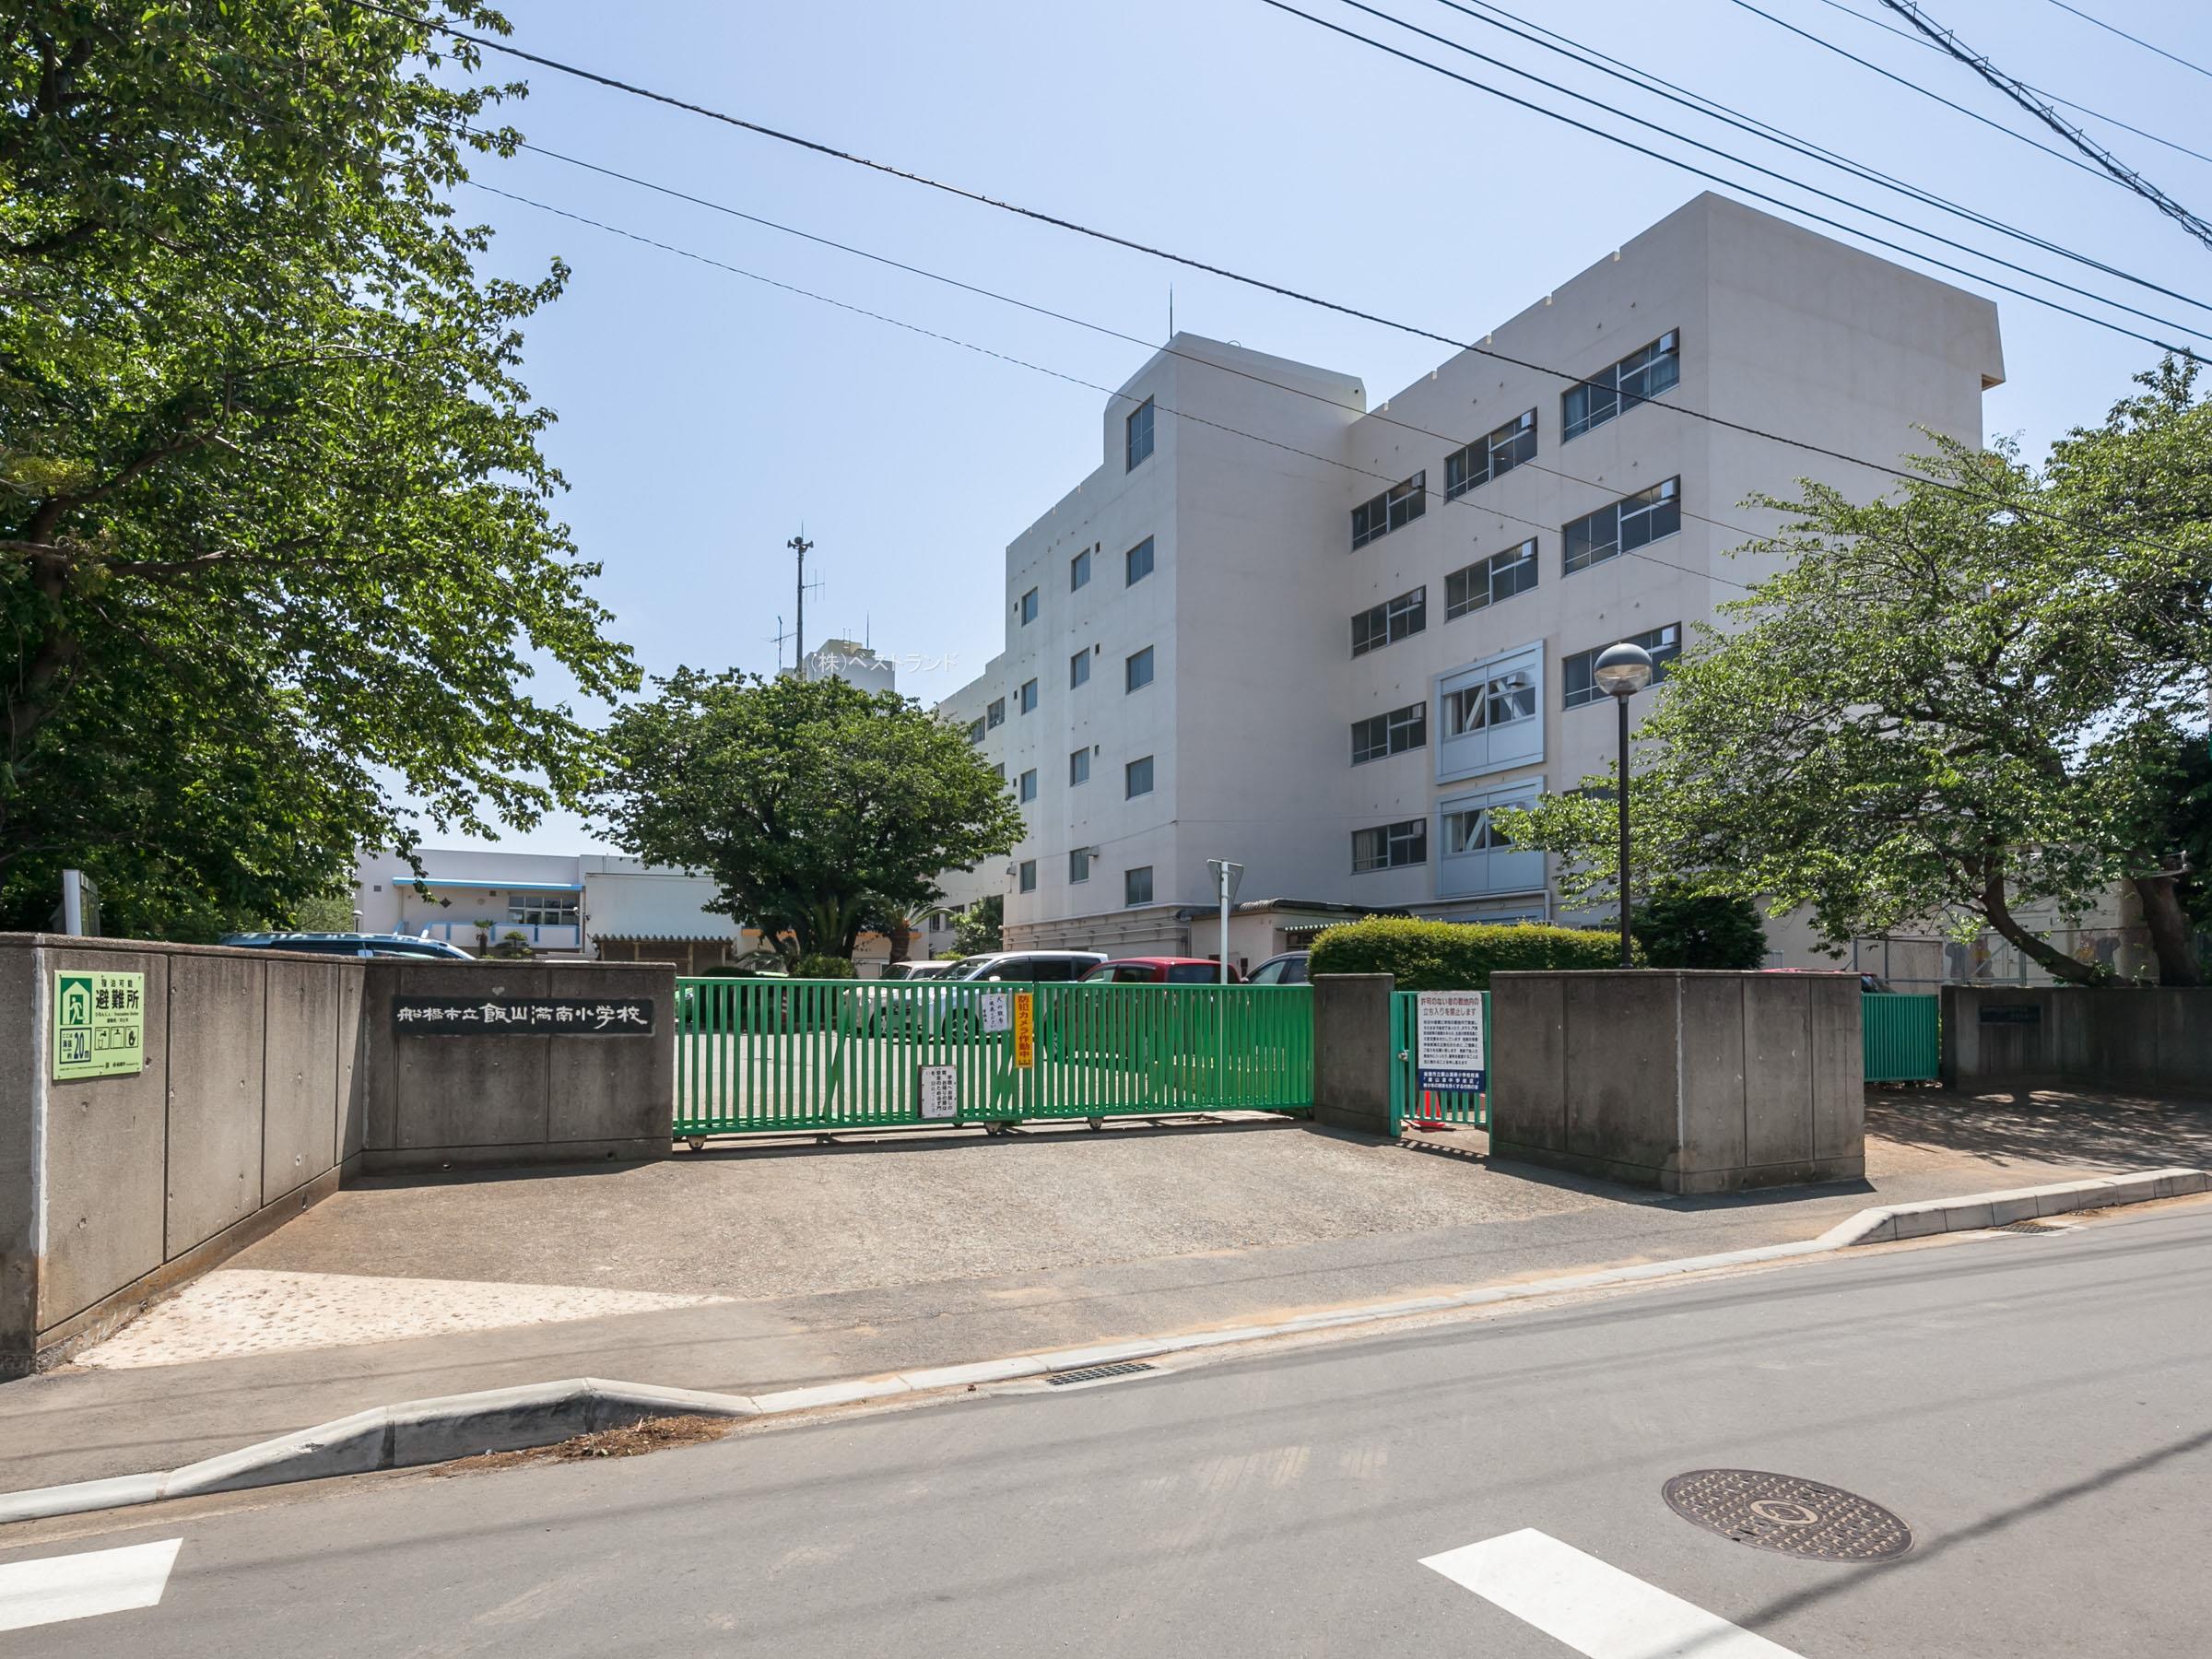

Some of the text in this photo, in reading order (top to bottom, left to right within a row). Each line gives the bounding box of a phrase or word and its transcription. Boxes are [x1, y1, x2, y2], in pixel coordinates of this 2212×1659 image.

[96, 989, 139, 1009] 避難所
[396, 1002, 649, 1030] 船橋市立飯山満南小学校
[1017, 994, 1030, 1058] 防犯カメラ作動中
